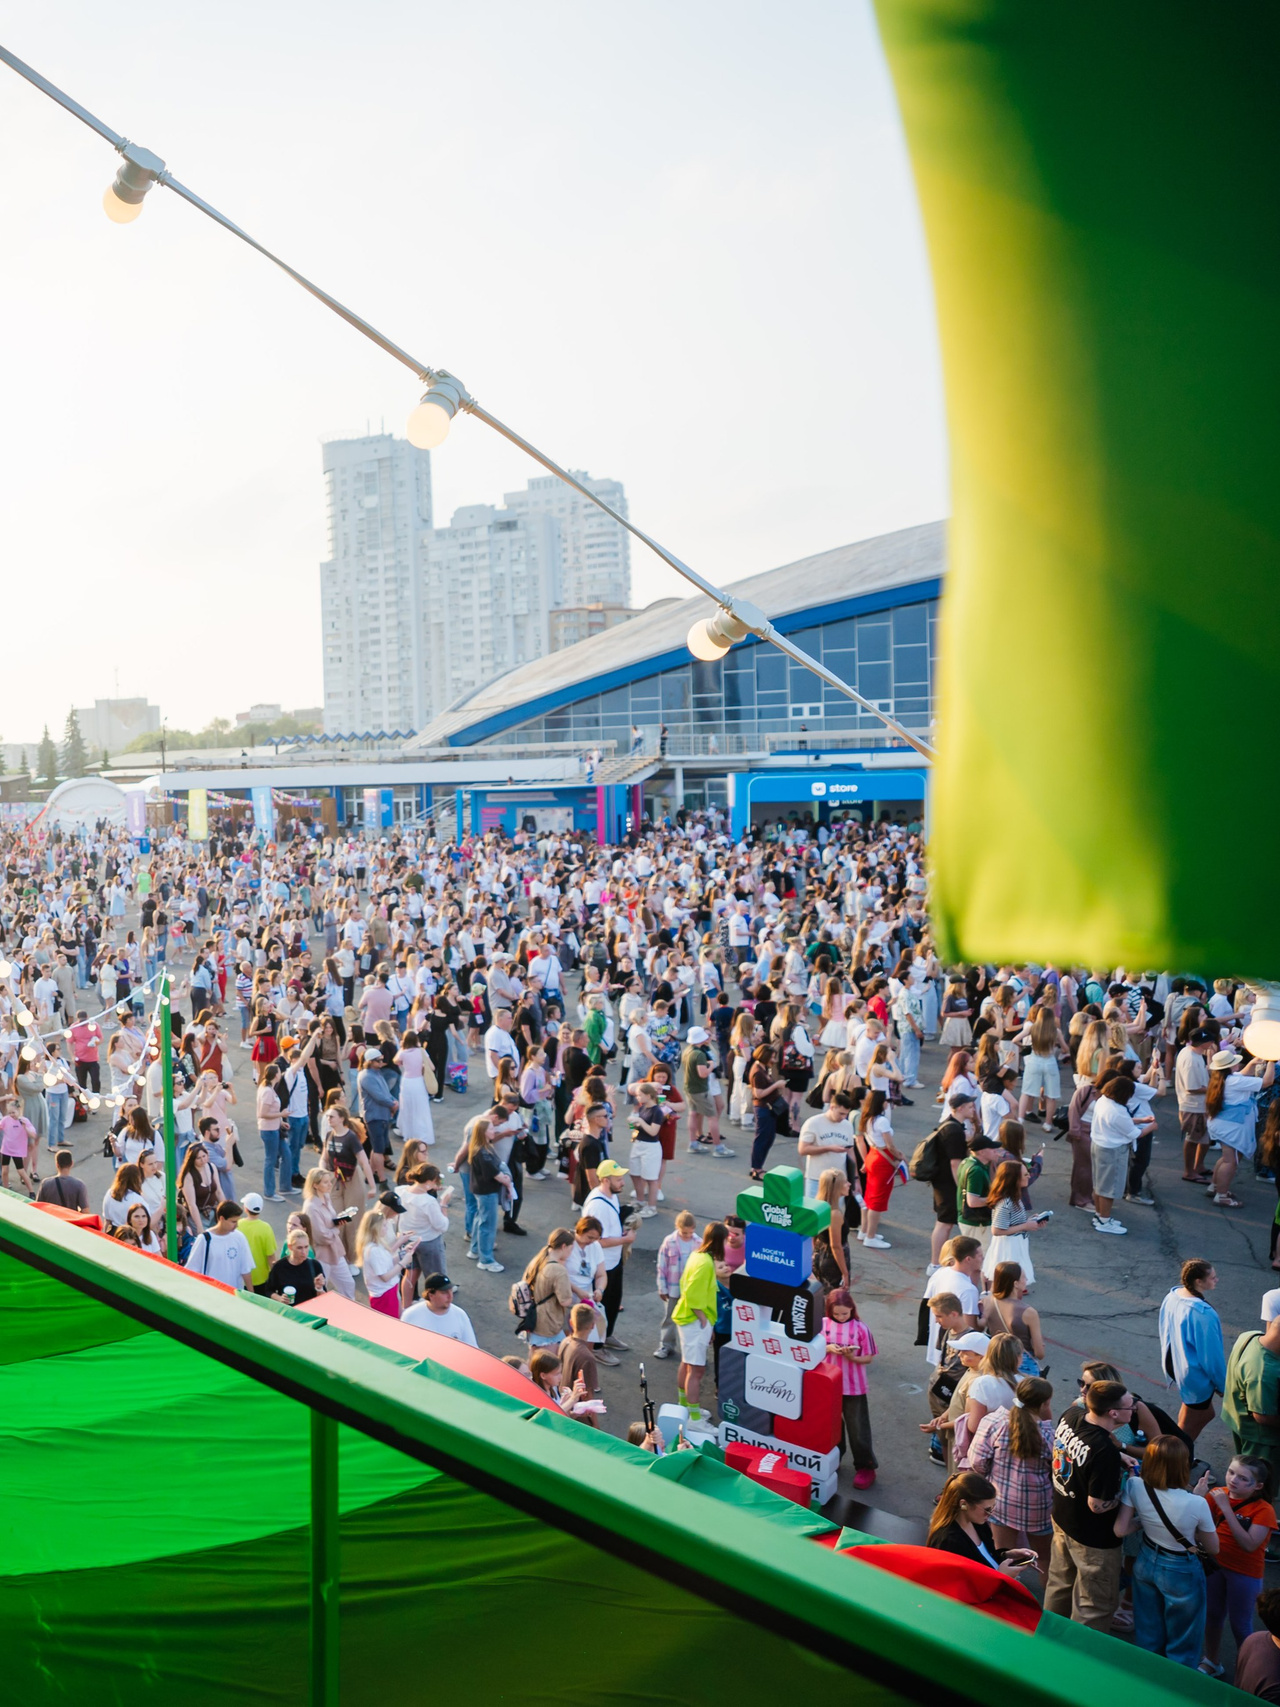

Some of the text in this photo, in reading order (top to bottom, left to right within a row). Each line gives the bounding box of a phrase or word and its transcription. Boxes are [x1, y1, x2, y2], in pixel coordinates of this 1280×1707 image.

[829, 784, 858, 792] store
[761, 1203, 788, 1215] Global
[764, 1212, 792, 1227] Village
[751, 1251, 795, 1267] MINÉRALE
[791, 1294, 809, 1335] TWISTER
